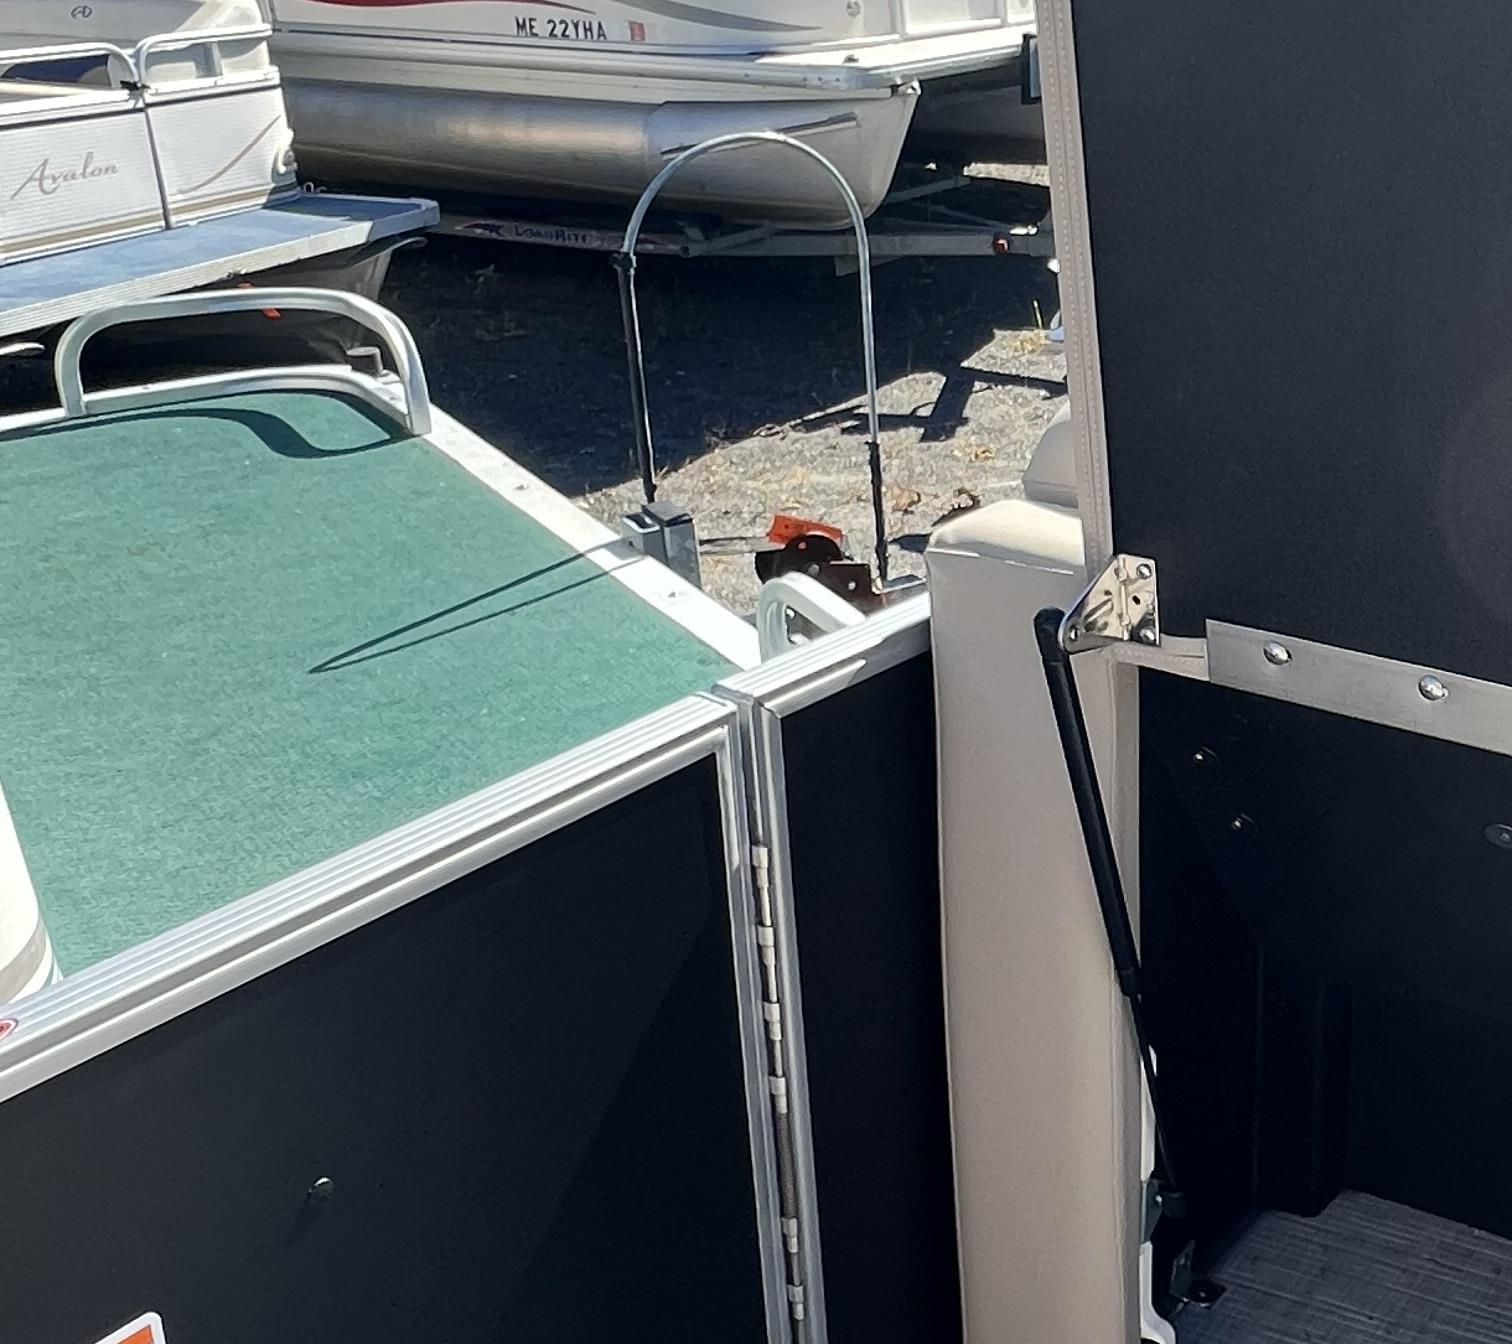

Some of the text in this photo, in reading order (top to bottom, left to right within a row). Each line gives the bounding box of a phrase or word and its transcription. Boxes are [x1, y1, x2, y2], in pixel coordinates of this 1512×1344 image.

[515, 16, 607, 41] ME 22YHA
[10, 151, 118, 199] Avalon
